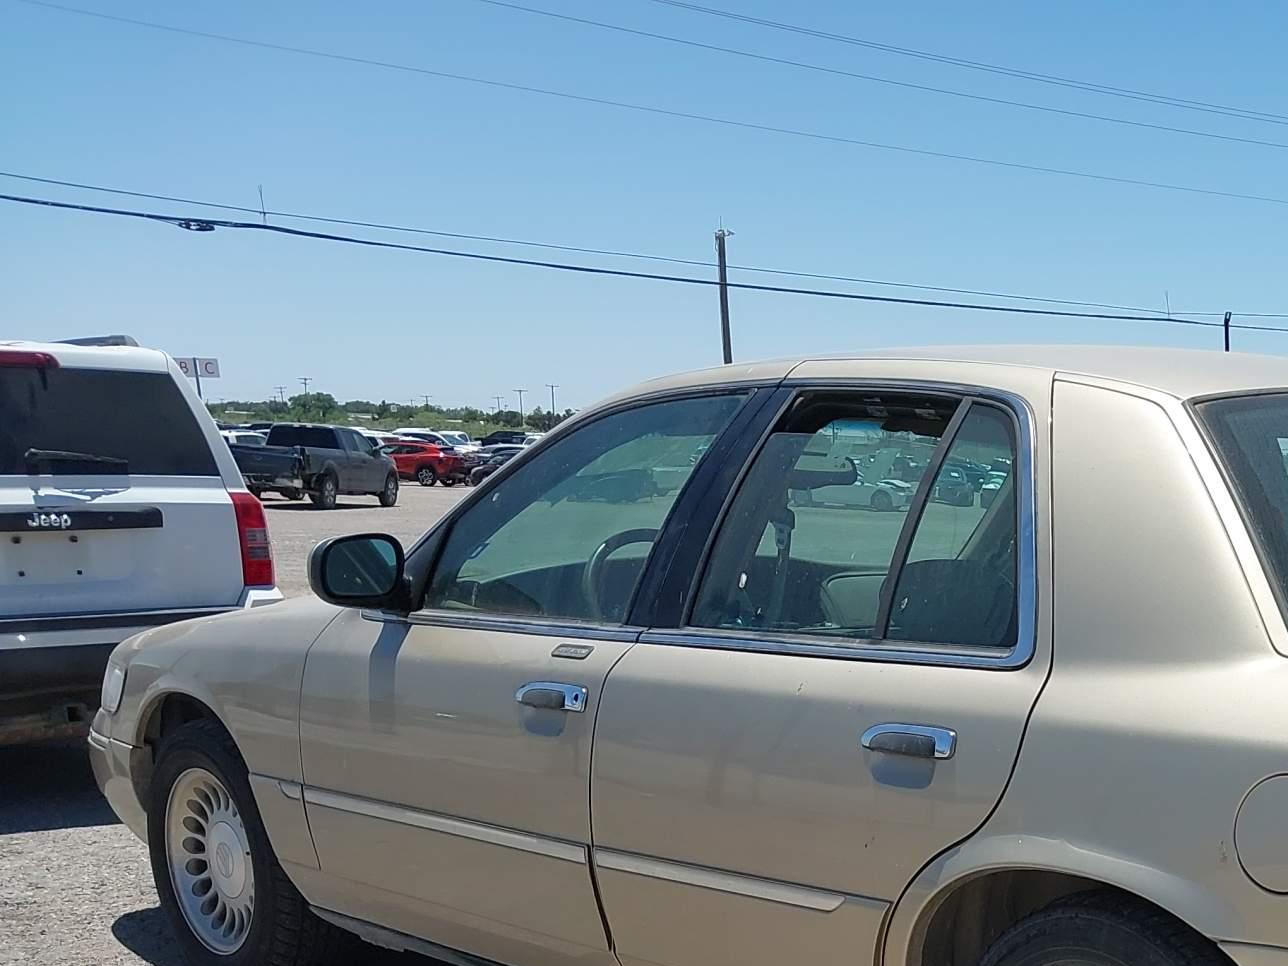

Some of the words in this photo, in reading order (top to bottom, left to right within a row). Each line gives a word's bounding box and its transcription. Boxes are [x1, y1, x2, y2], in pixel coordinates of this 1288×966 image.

[179, 361, 189, 374] B
[204, 361, 216, 375] C
[27, 512, 72, 529] Jeep
